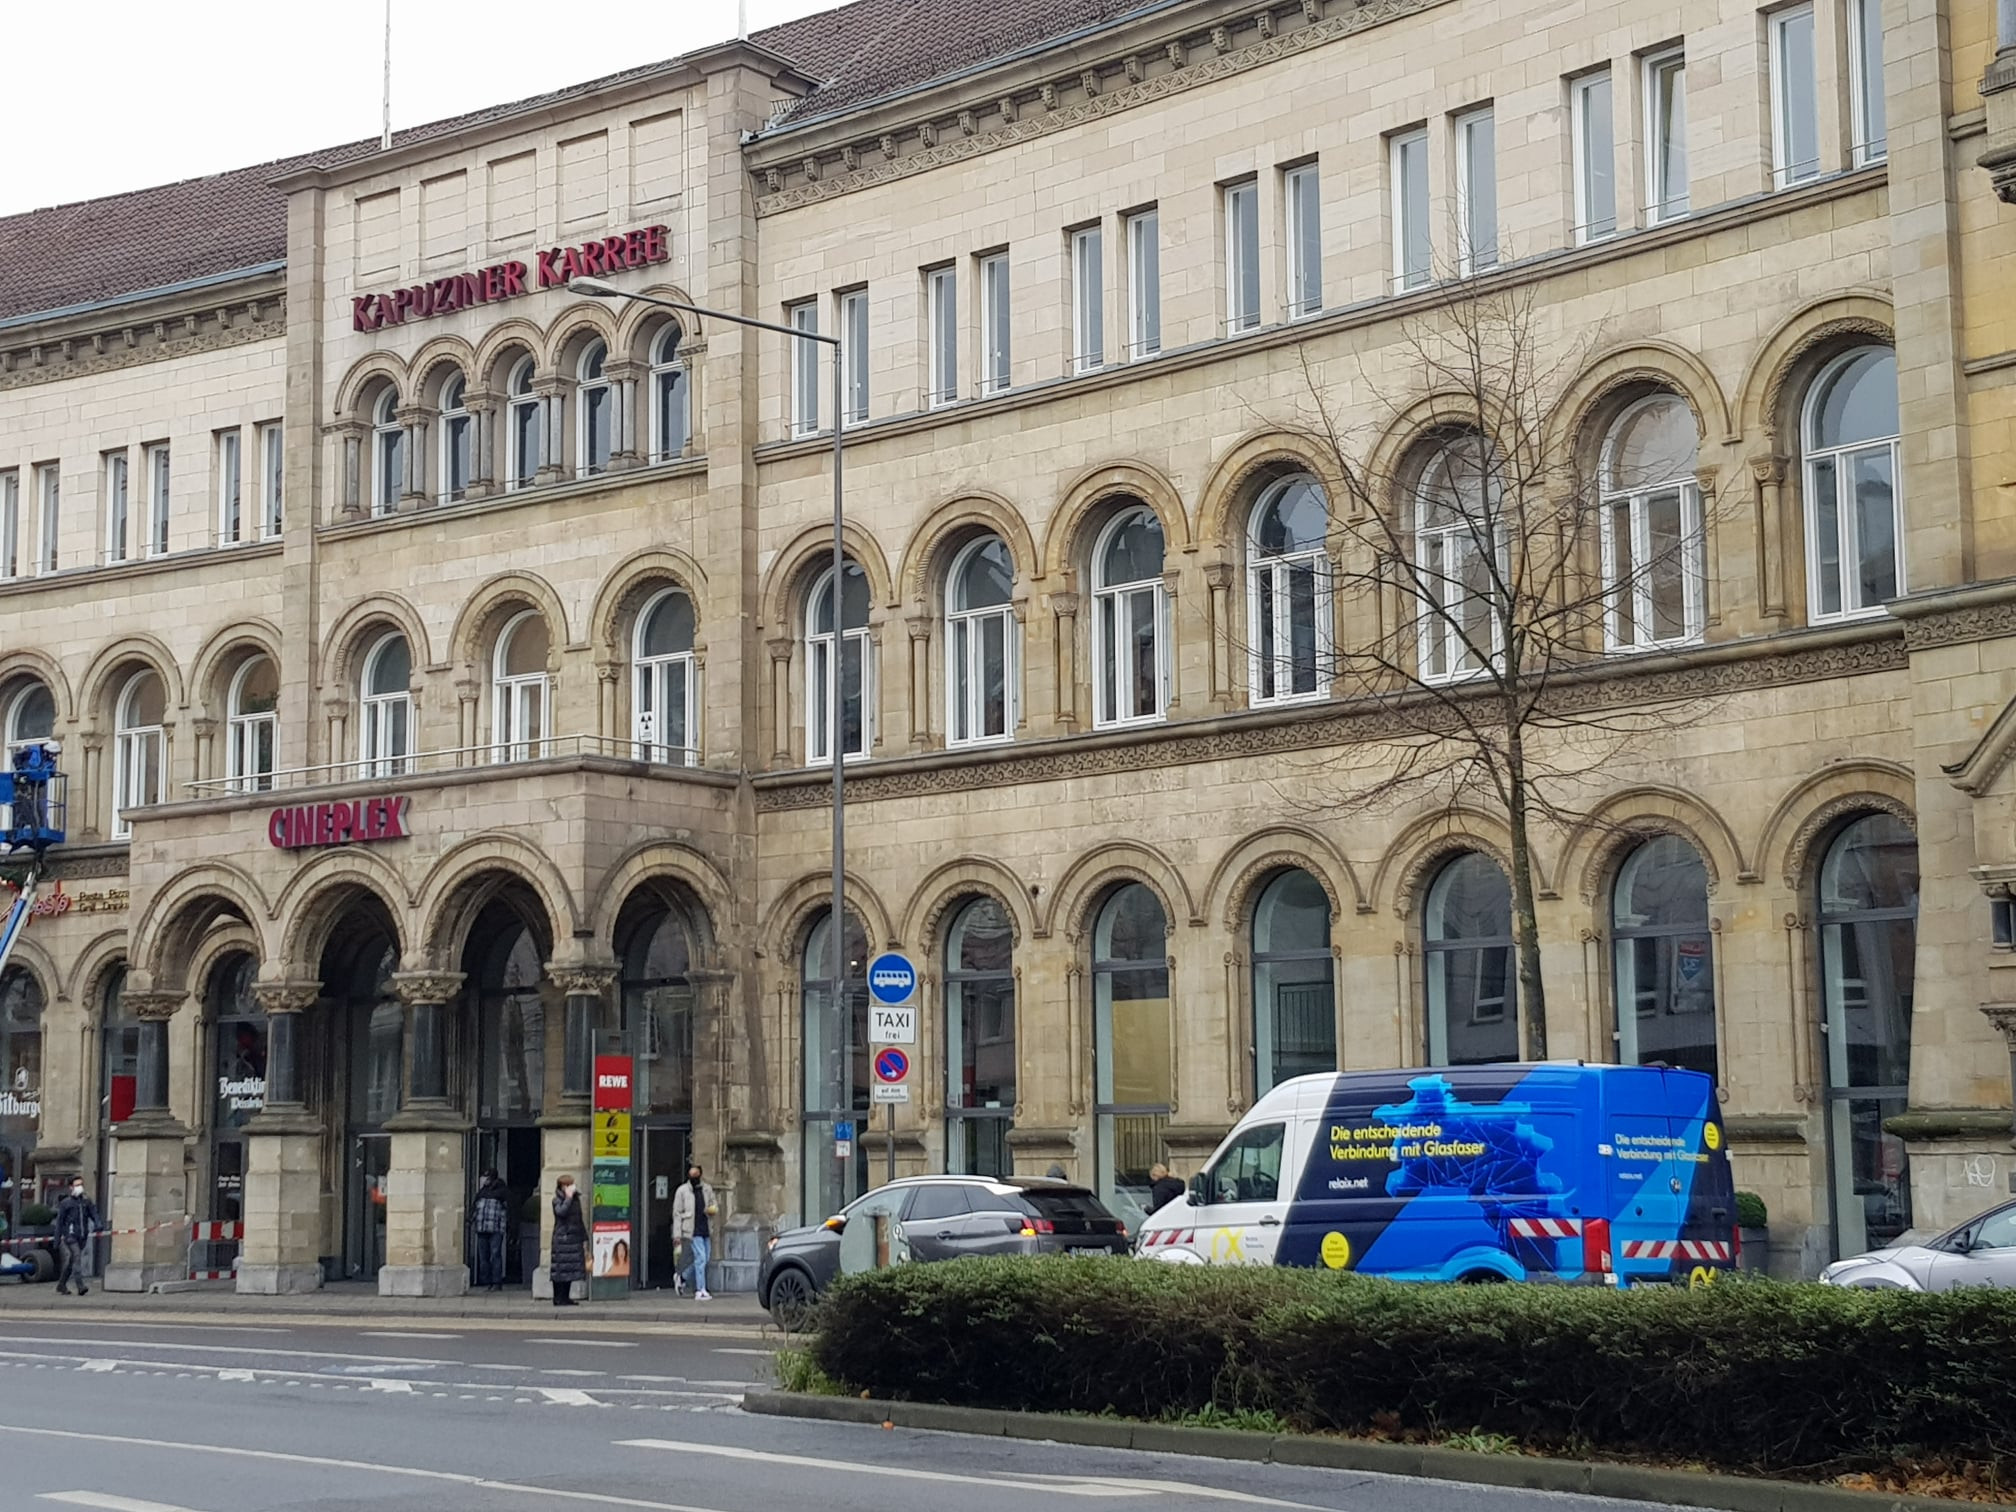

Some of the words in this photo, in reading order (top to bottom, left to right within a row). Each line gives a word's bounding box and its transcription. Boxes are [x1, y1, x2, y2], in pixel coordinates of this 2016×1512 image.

[351, 260, 529, 332] KAPUZINER
[536, 224, 671, 288] KARREE
[269, 796, 409, 848] CINEPLEX
[876, 1012, 909, 1028] TAXI
[885, 1031, 901, 1039] frei
[599, 1075, 628, 1088] REWE
[1330, 1126, 1350, 1141] Die
[1353, 1122, 1441, 1140] entscheidende
[1615, 1133, 1630, 1145] Die
[1330, 1143, 1398, 1162] Verbindung
[1401, 1142, 1422, 1157] mit
[1423, 1140, 1485, 1156] Glasfaser
[1616, 1148, 1662, 1162] Verbindung
[1328, 1176, 1369, 1190] relaix.net
